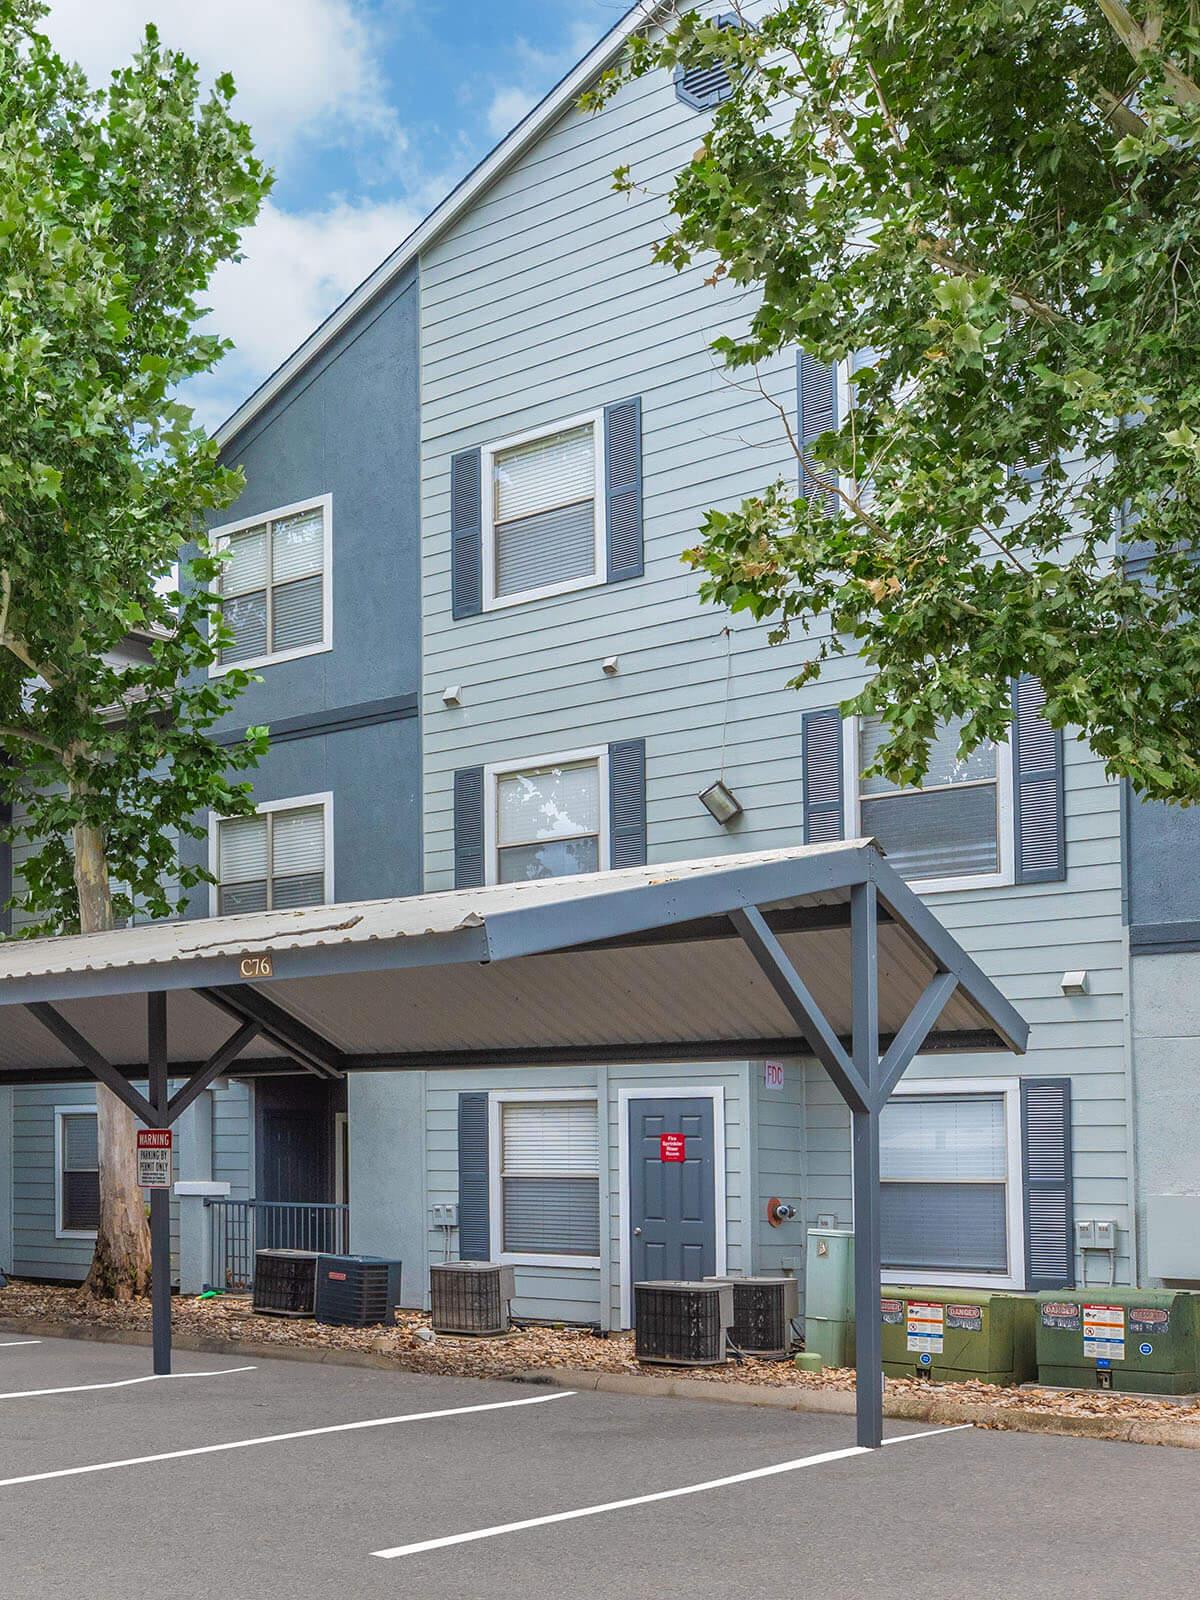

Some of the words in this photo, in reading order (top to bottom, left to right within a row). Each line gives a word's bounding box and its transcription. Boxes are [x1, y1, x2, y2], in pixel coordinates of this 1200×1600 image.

[241, 957, 270, 976] C76
[767, 1065, 784, 1085] FDC
[139, 1133, 169, 1147] WARNING
[140, 1150, 160, 1161] PARKING
[950, 1308, 977, 1317] DANGER
[1046, 1305, 1075, 1315] DANGER
